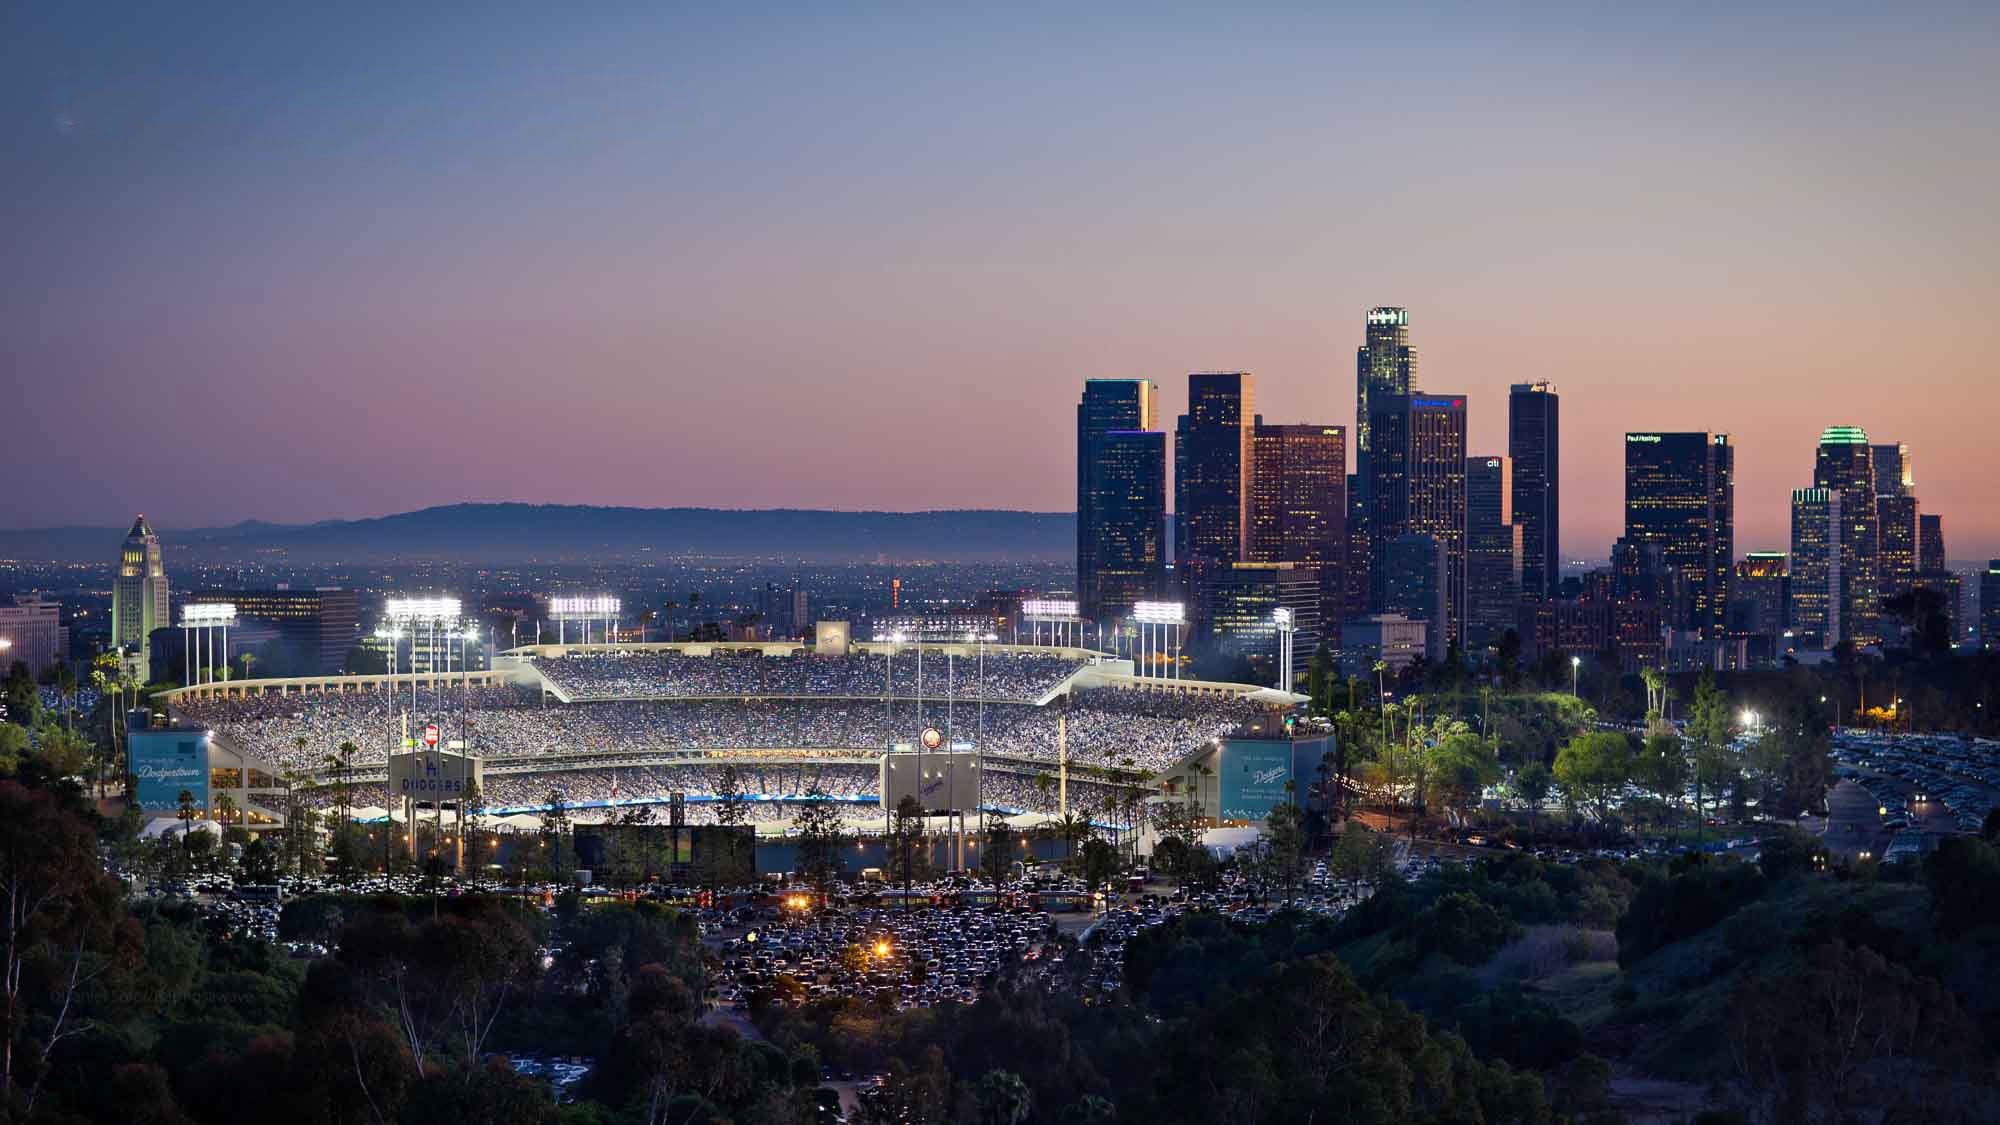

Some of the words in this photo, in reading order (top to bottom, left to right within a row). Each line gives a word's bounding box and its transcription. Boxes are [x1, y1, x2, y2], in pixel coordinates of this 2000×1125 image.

[1639, 435, 1661, 443] Hastings
[1487, 459, 1499, 468] citi
[137, 765, 200, 782] Dodgertown
[1253, 766, 1287, 785] Dodgers
[402, 778, 461, 792] DODGERS
